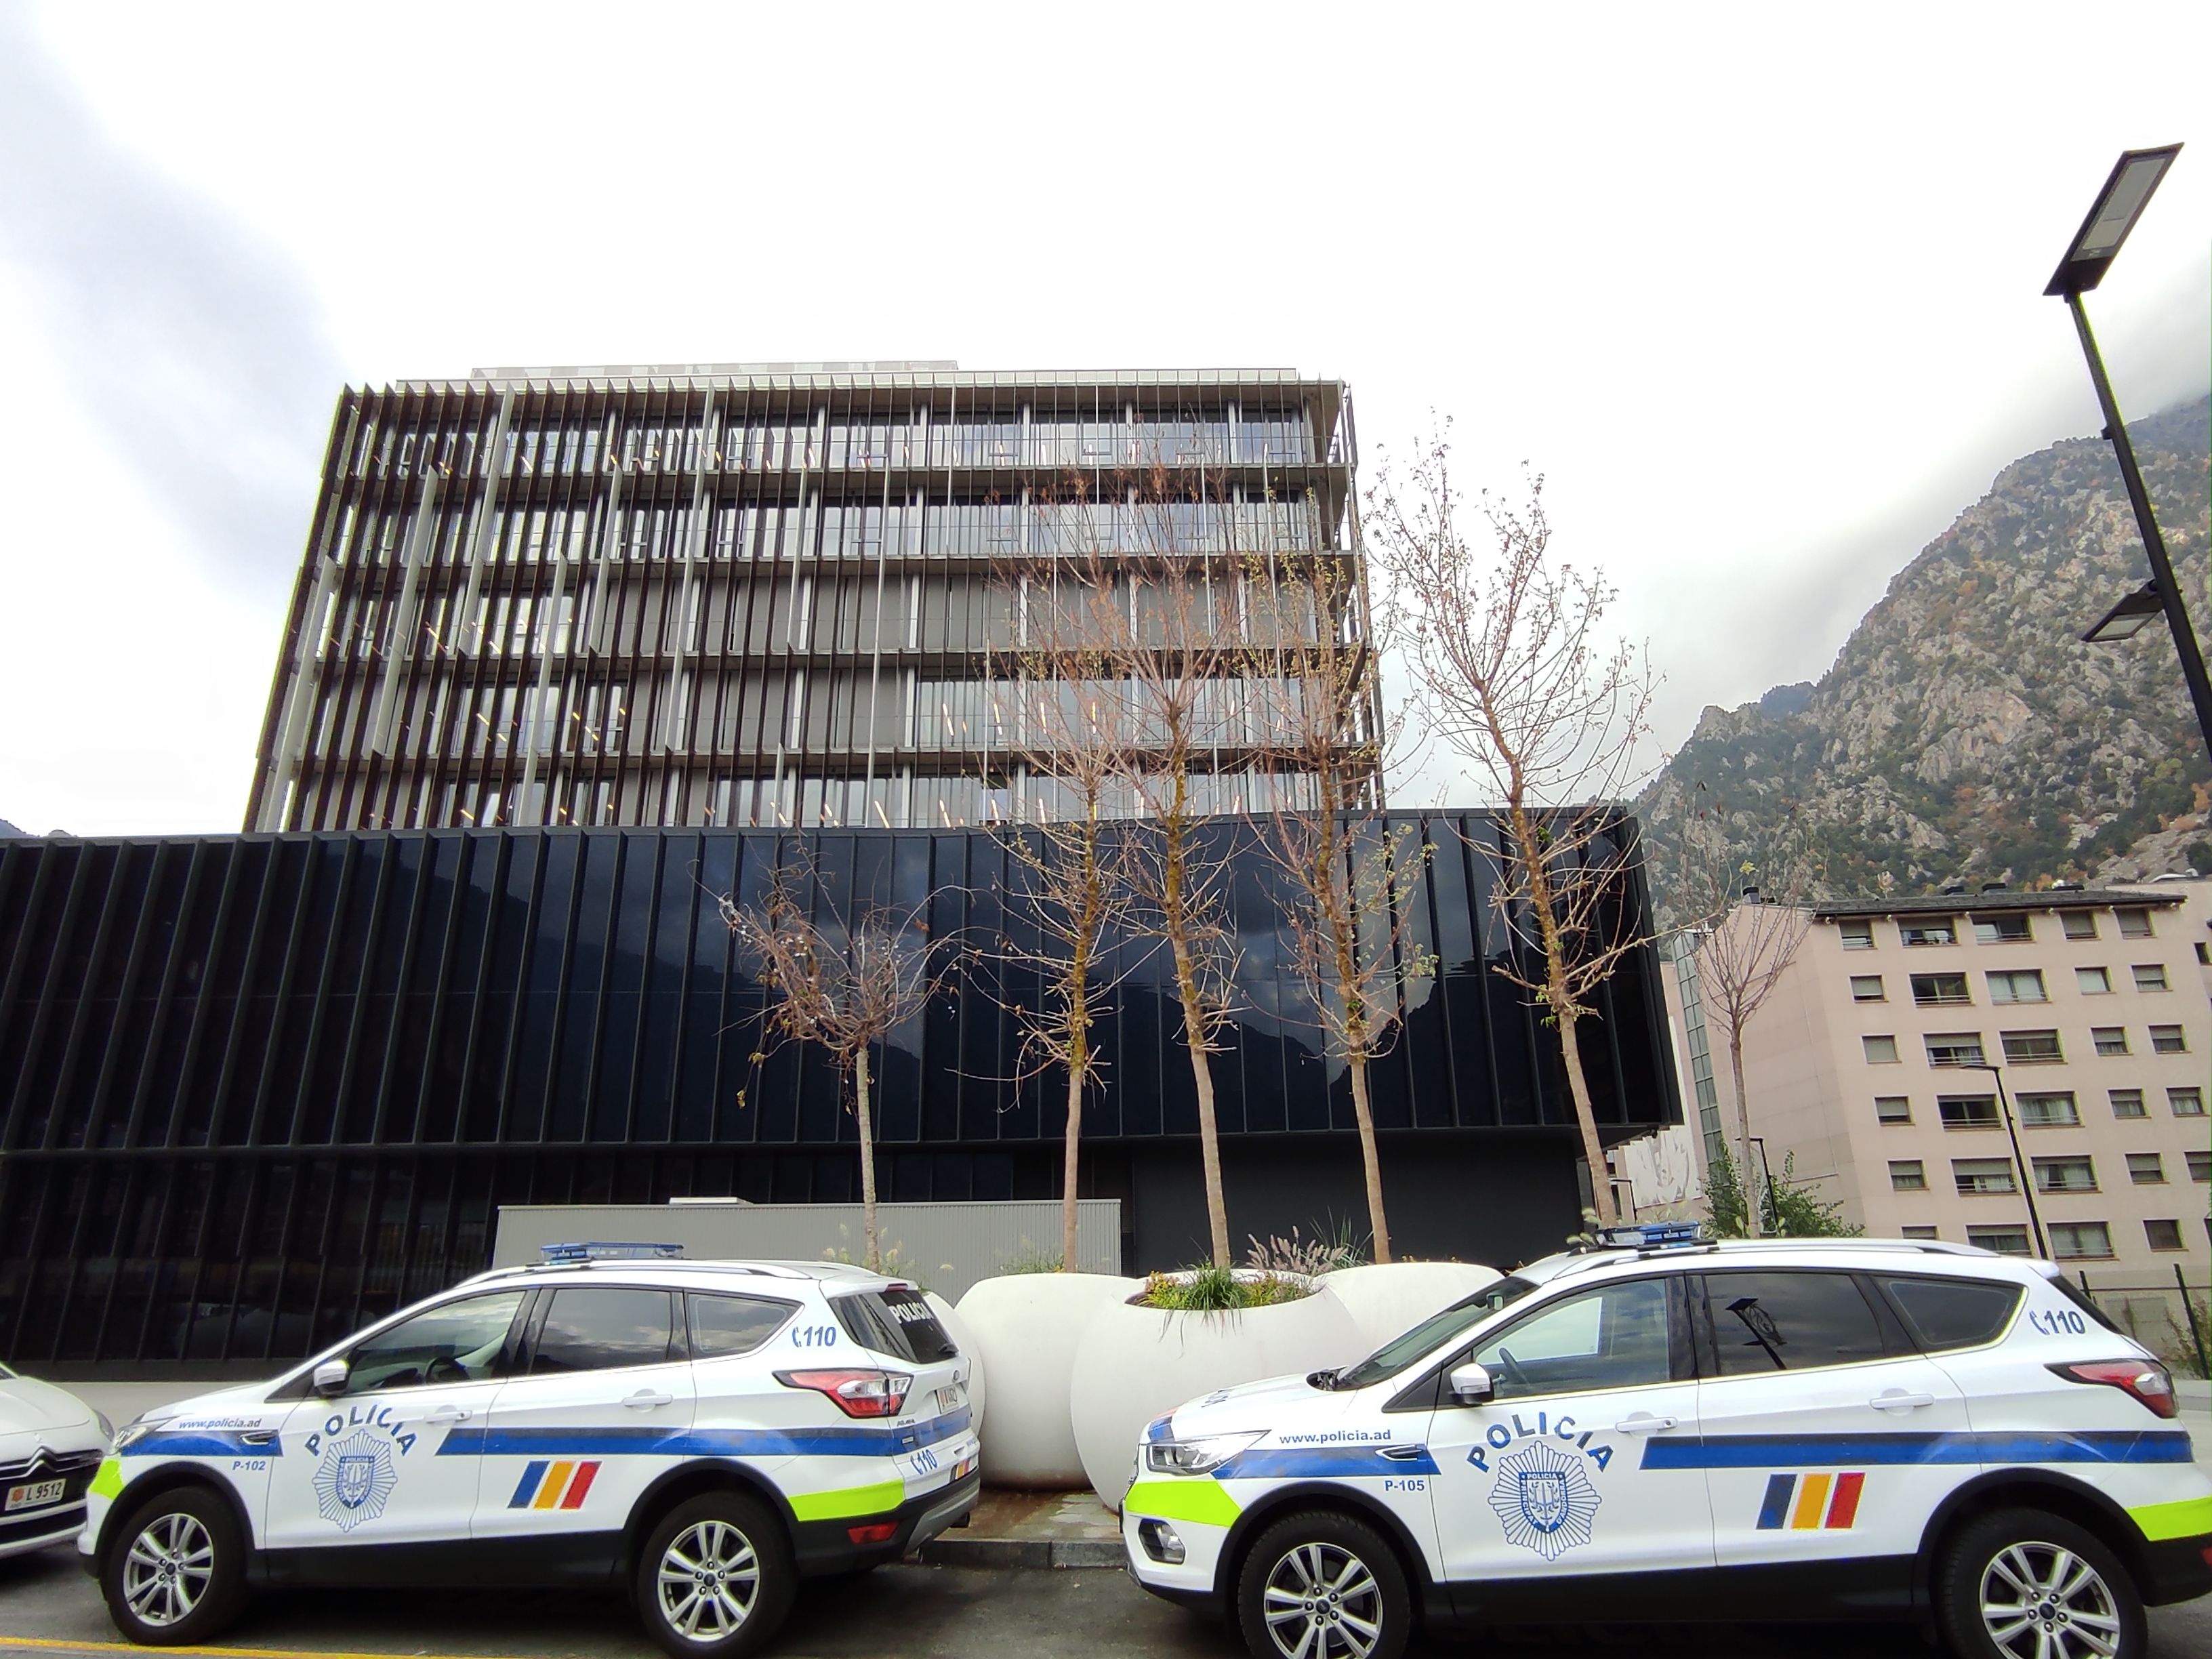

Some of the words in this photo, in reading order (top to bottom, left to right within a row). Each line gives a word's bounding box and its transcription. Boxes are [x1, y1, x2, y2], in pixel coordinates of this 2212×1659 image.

[888, 1302, 935, 1324] POLICIA
[2044, 1310, 2085, 1334] 110
[803, 1326, 836, 1347] 110
[179, 1418, 262, 1429] www.policia.ad
[306, 1404, 417, 1456] POLICIA
[1279, 1429, 1391, 1444] www.policia.ad
[1467, 1412, 1614, 1473] POLICIA
[232, 1460, 266, 1471] P-102
[917, 1449, 938, 1472] 110
[26, 1487, 33, 1500] L
[36, 1481, 62, 1499] 9512
[1385, 1480, 1425, 1492] P-105
[1520, 1479, 1538, 1525] PRINCIPAT
